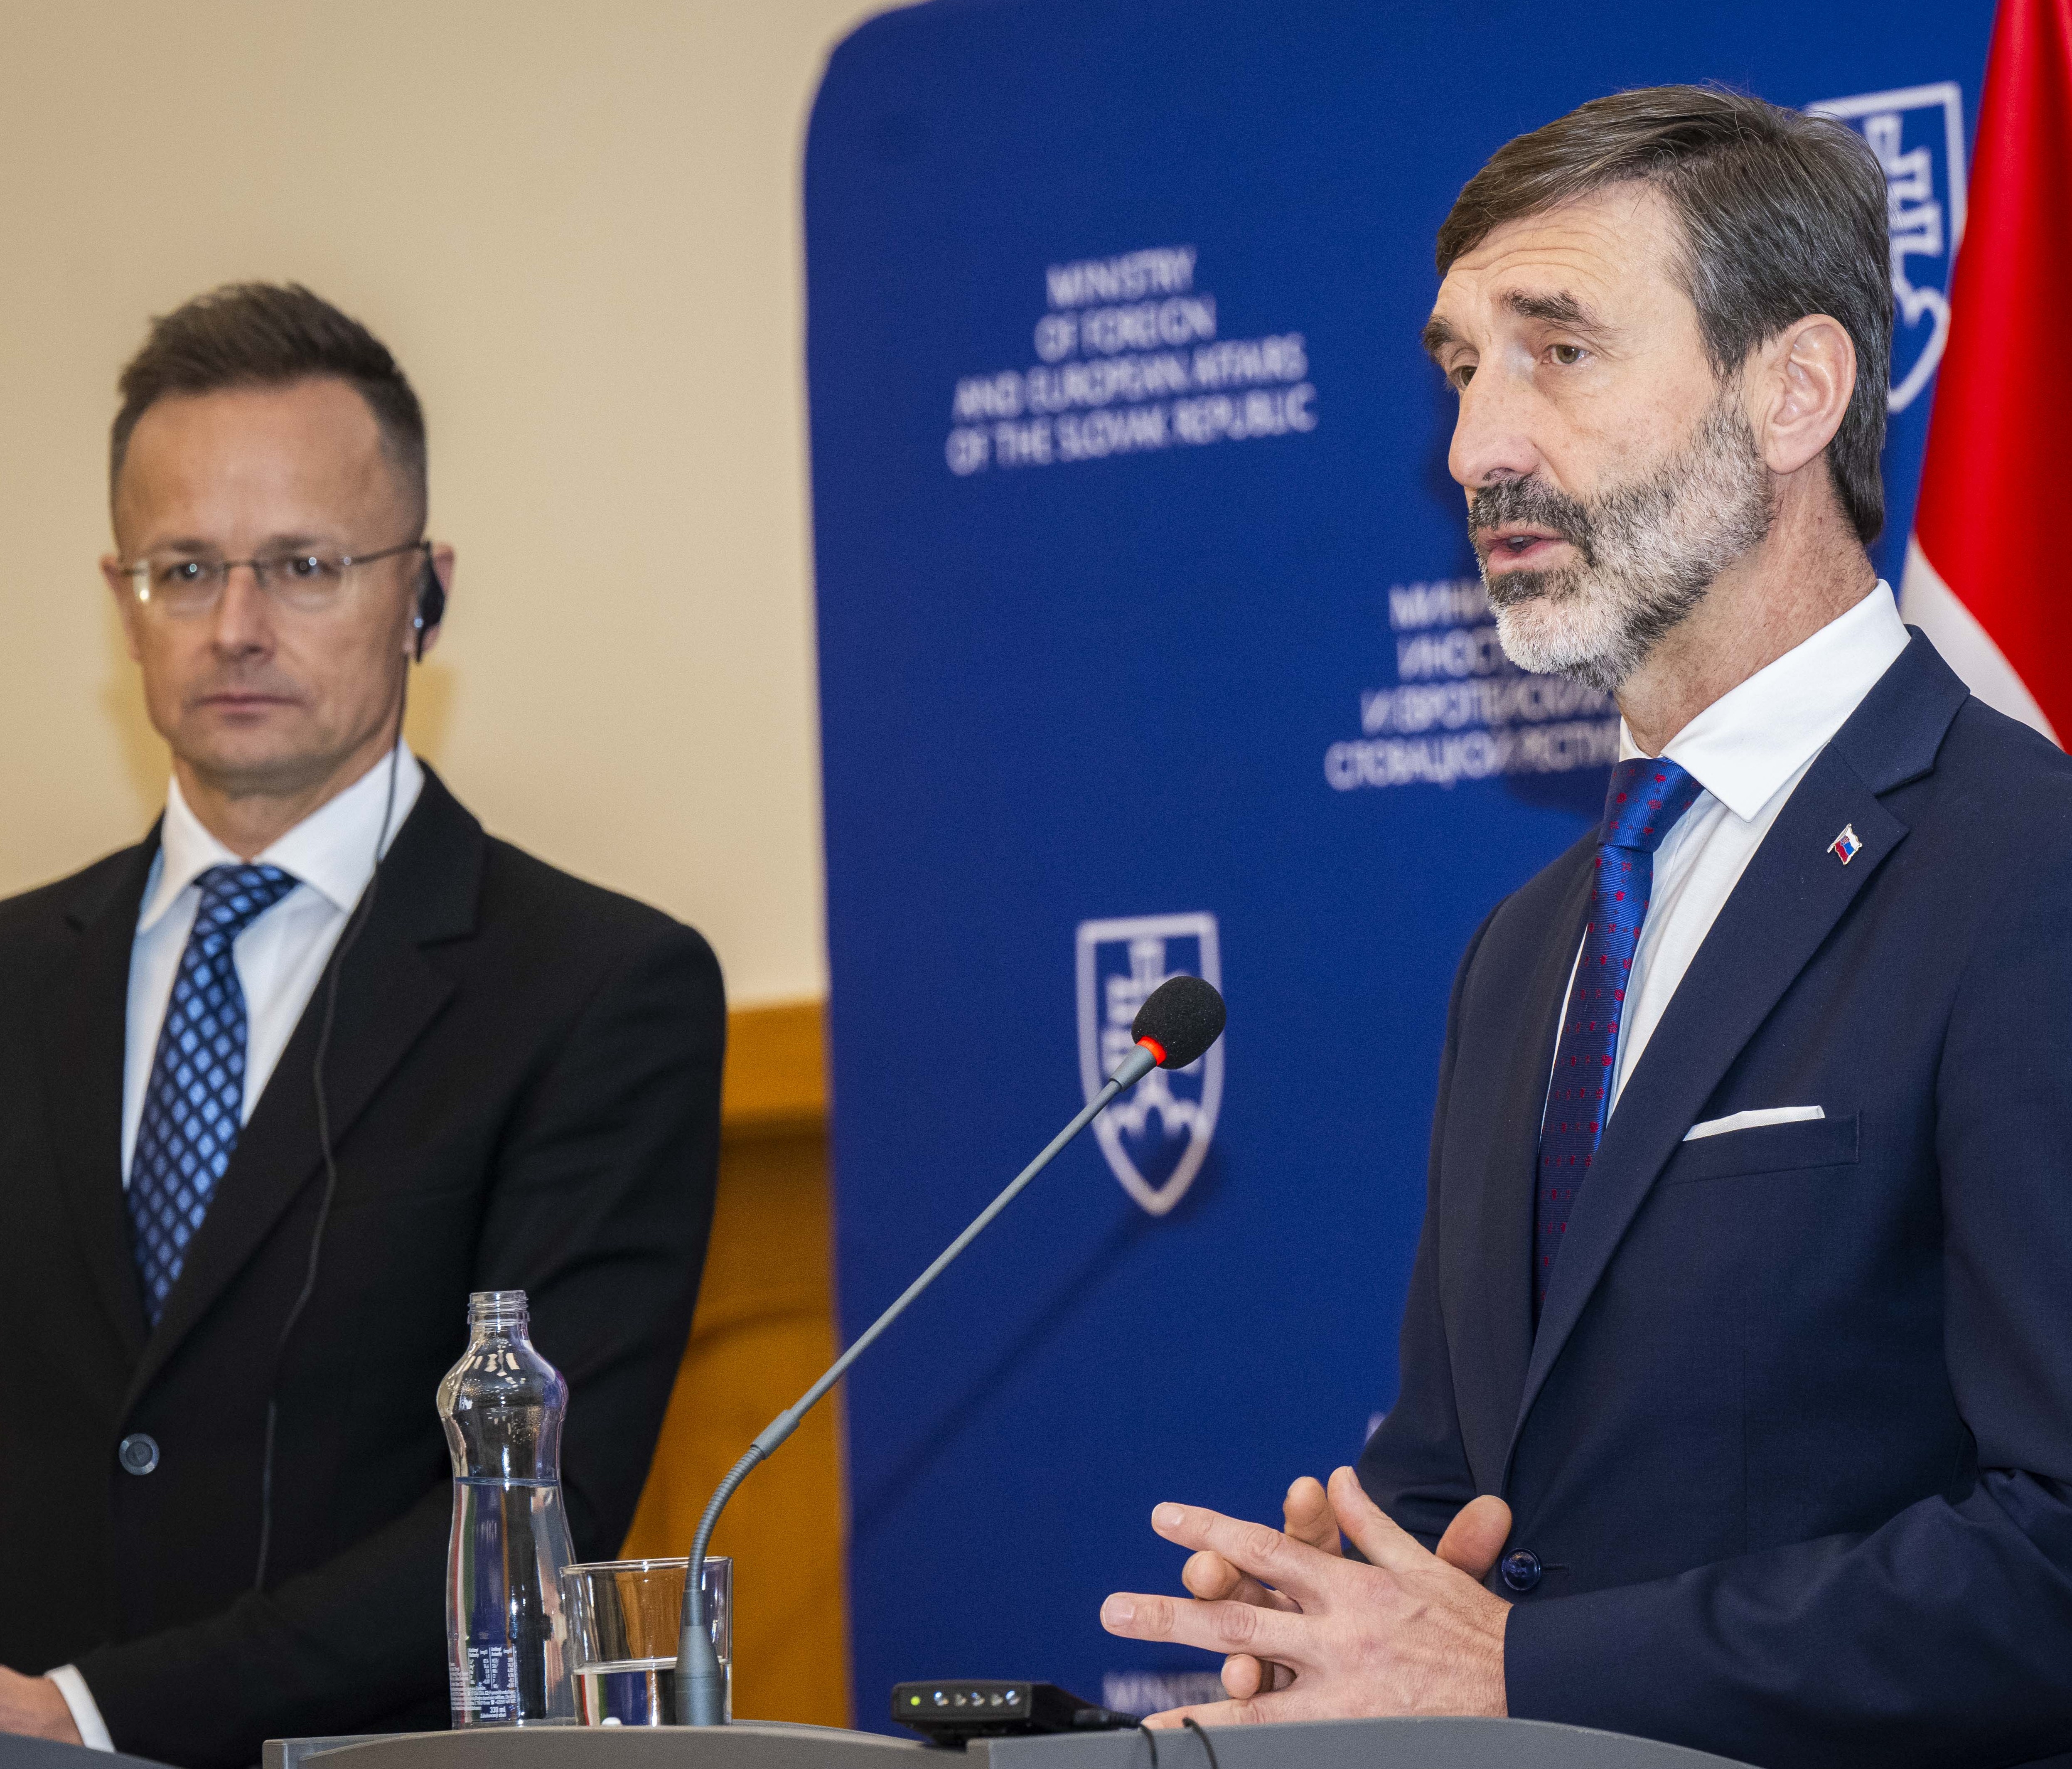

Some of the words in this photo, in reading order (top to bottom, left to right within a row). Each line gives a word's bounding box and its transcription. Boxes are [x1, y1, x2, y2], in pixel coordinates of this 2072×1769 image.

[1047, 245, 1195, 308] MINISTRY
[1036, 312, 1079, 360] OF
[1083, 294, 1216, 353] FOREIGN
[953, 371, 1023, 421] AND
[1028, 349, 1187, 411] EUROPEAN
[1193, 334, 1308, 389] AFFAIRS
[946, 426, 989, 474] OF
[992, 419, 1052, 467] THE
[1057, 404, 1167, 460] SLOVAK
[1172, 383, 1317, 443] REPUBLIC
